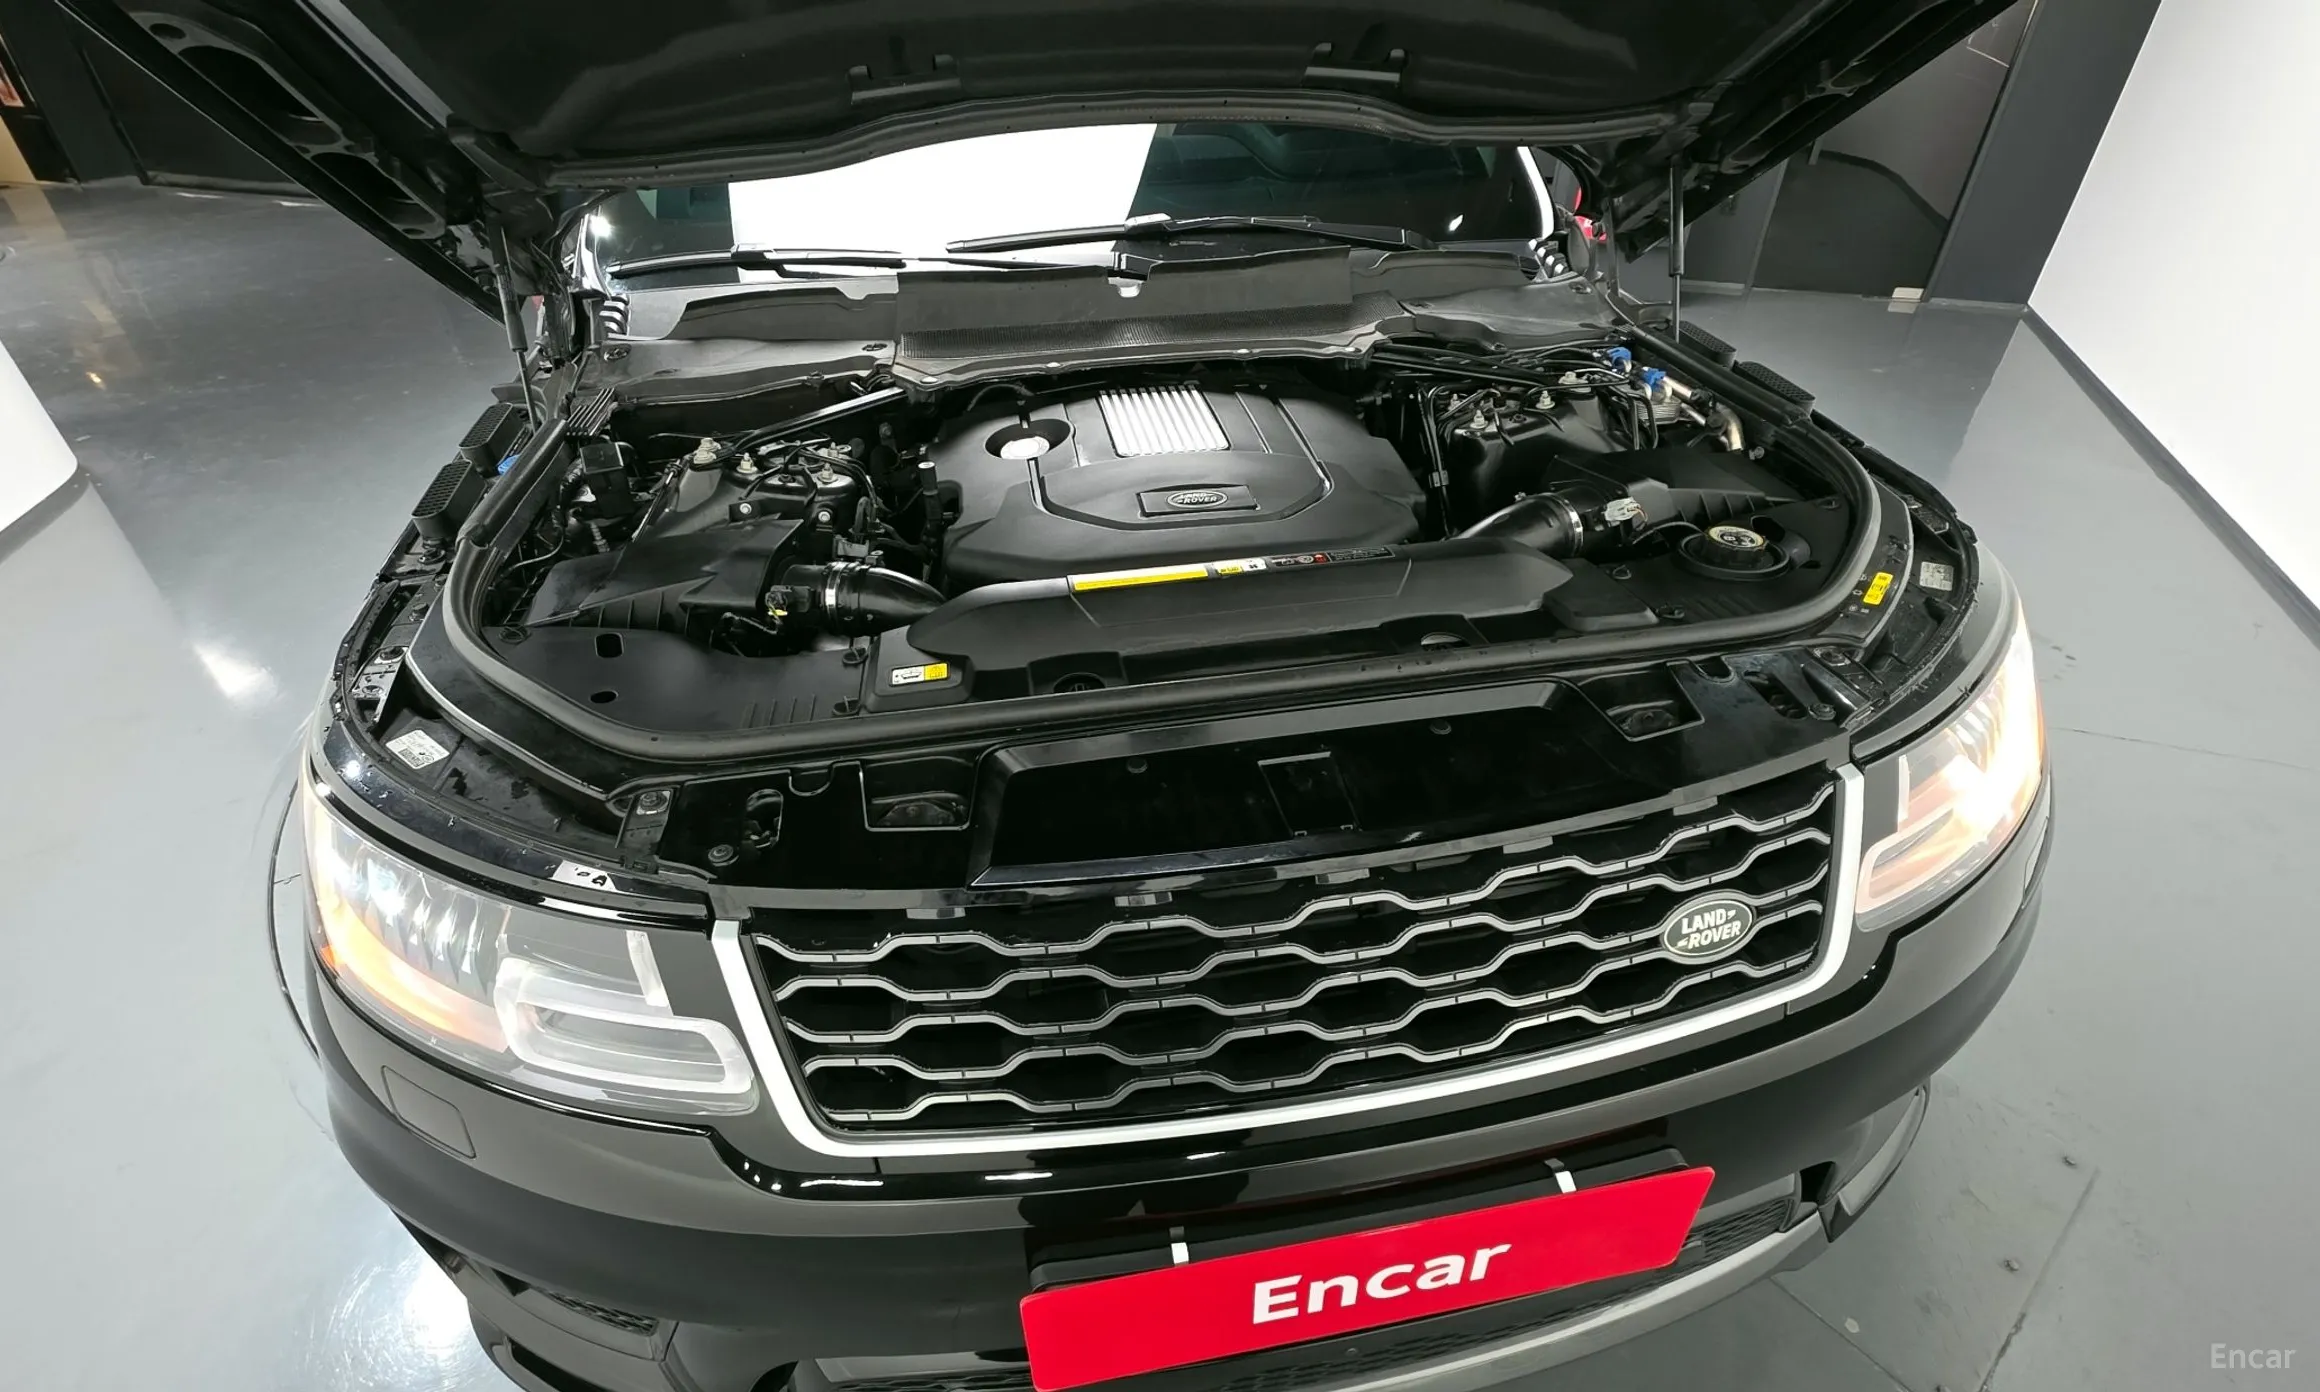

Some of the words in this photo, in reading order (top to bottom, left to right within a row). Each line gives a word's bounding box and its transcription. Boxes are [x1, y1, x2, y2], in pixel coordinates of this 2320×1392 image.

[1184, 496, 1217, 504] ROVER
[1682, 908, 1726, 934] LAND
[1687, 920, 1742, 949] ROVER
[1253, 1243, 1512, 1324] Encar
